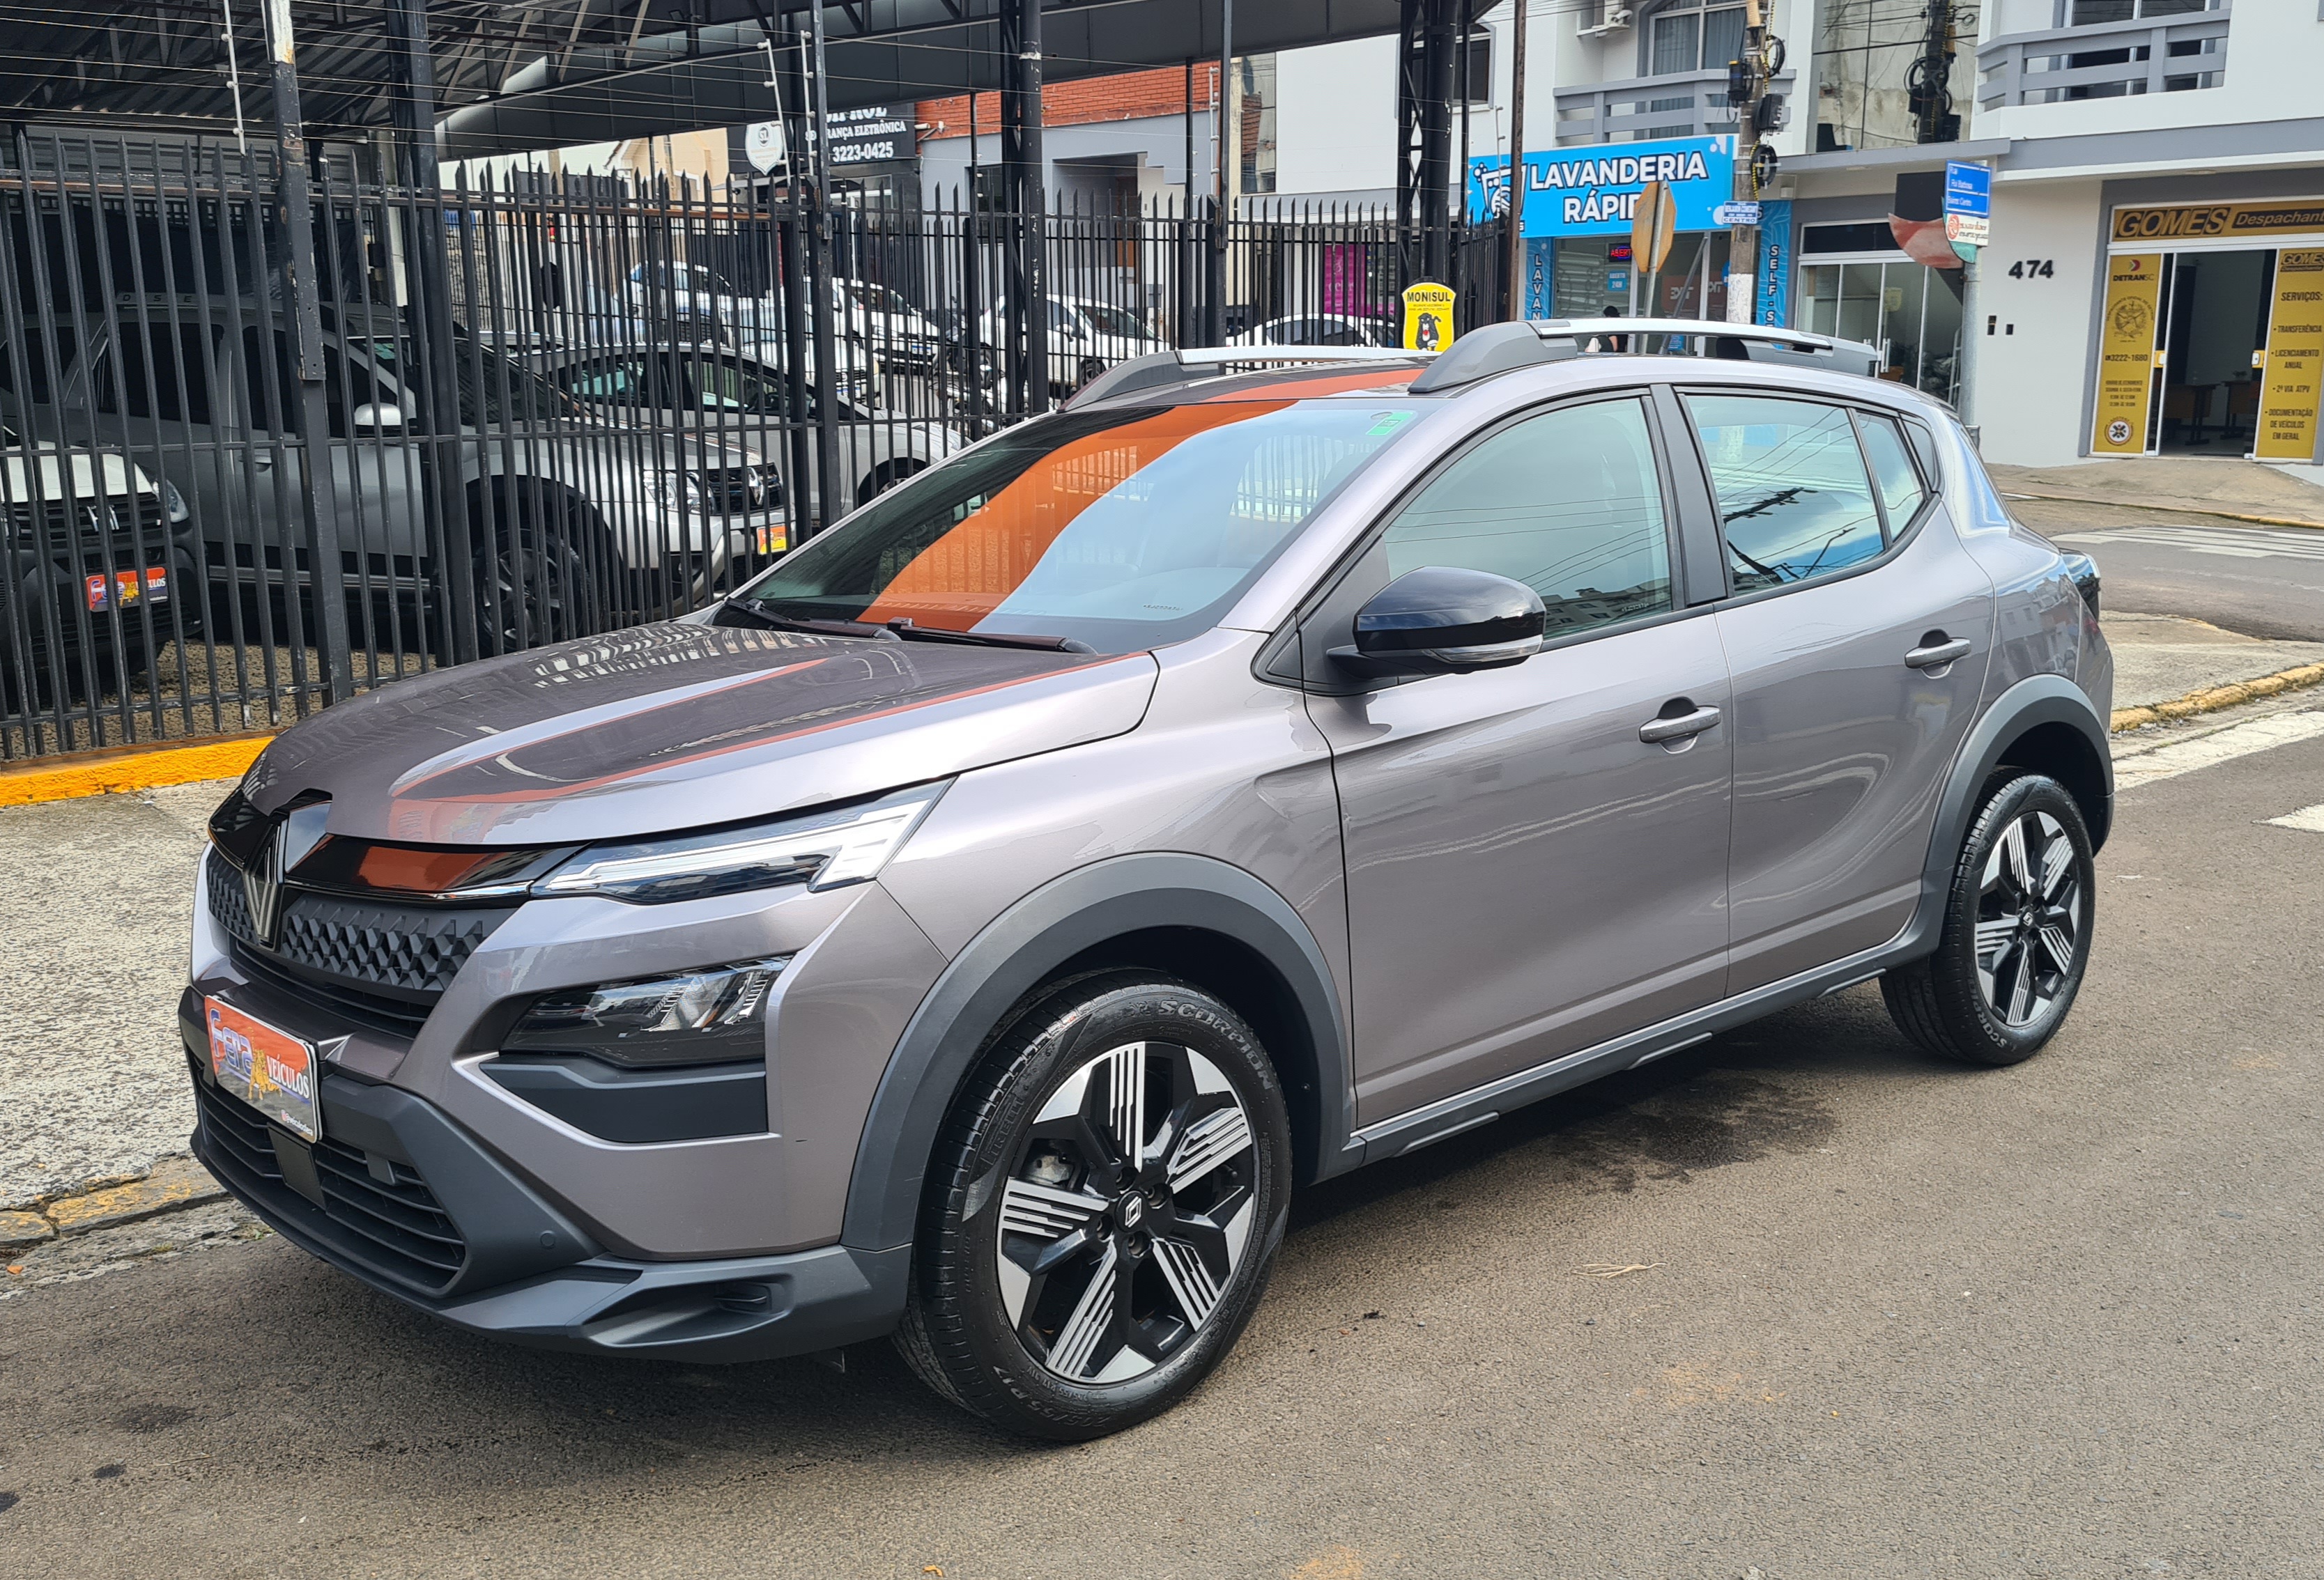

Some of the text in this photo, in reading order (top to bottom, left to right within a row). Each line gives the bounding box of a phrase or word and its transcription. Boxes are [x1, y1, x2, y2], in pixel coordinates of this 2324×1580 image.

[805, 120, 907, 141] SERANÇA ELETRÔNICA
[832, 141, 893, 162] 3223-0425
[1530, 151, 1709, 191] LAVANDERIA
[2116, 208, 2229, 238] GOMES
[1610, 249, 1632, 257] ABERT
[2008, 260, 2054, 279] 474
[1407, 292, 1451, 302] MONISUL
[2281, 292, 2323, 302] SERVIÇOS:
[2278, 324, 2322, 332] TRANSFERÊNCIA
[2268, 408, 2314, 417] DOCUMENTAÇÃO
[1158, 999, 1274, 1090] SCORPION
[266, 1053, 311, 1099] VEÍCULOS
